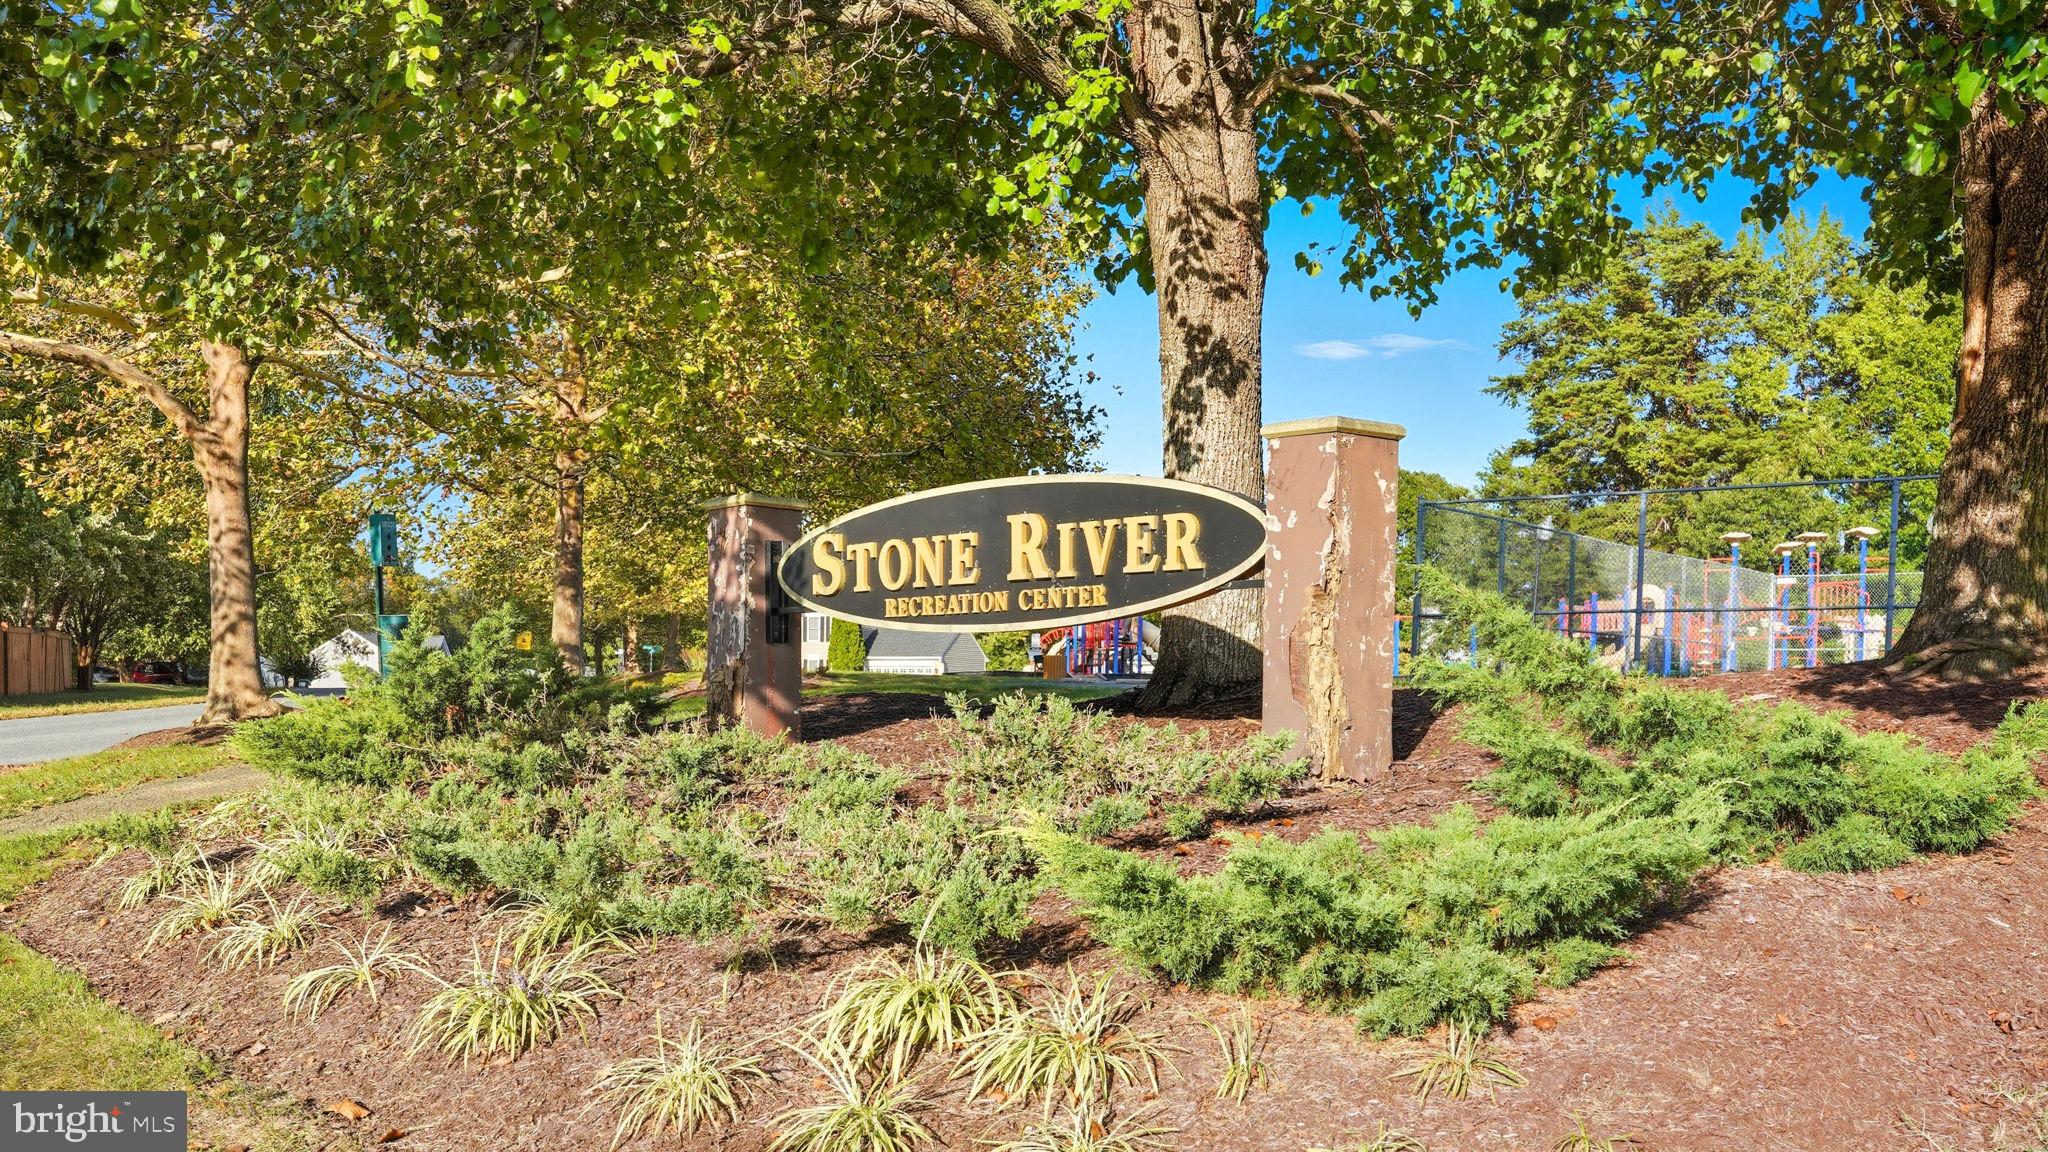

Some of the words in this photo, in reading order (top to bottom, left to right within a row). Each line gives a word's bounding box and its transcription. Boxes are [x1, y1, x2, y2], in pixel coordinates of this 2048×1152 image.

[812, 531, 981, 596] STONE
[1006, 512, 1206, 582] RIVER
[885, 590, 1009, 618] RECREATION
[1018, 585, 1107, 611] CENTER
